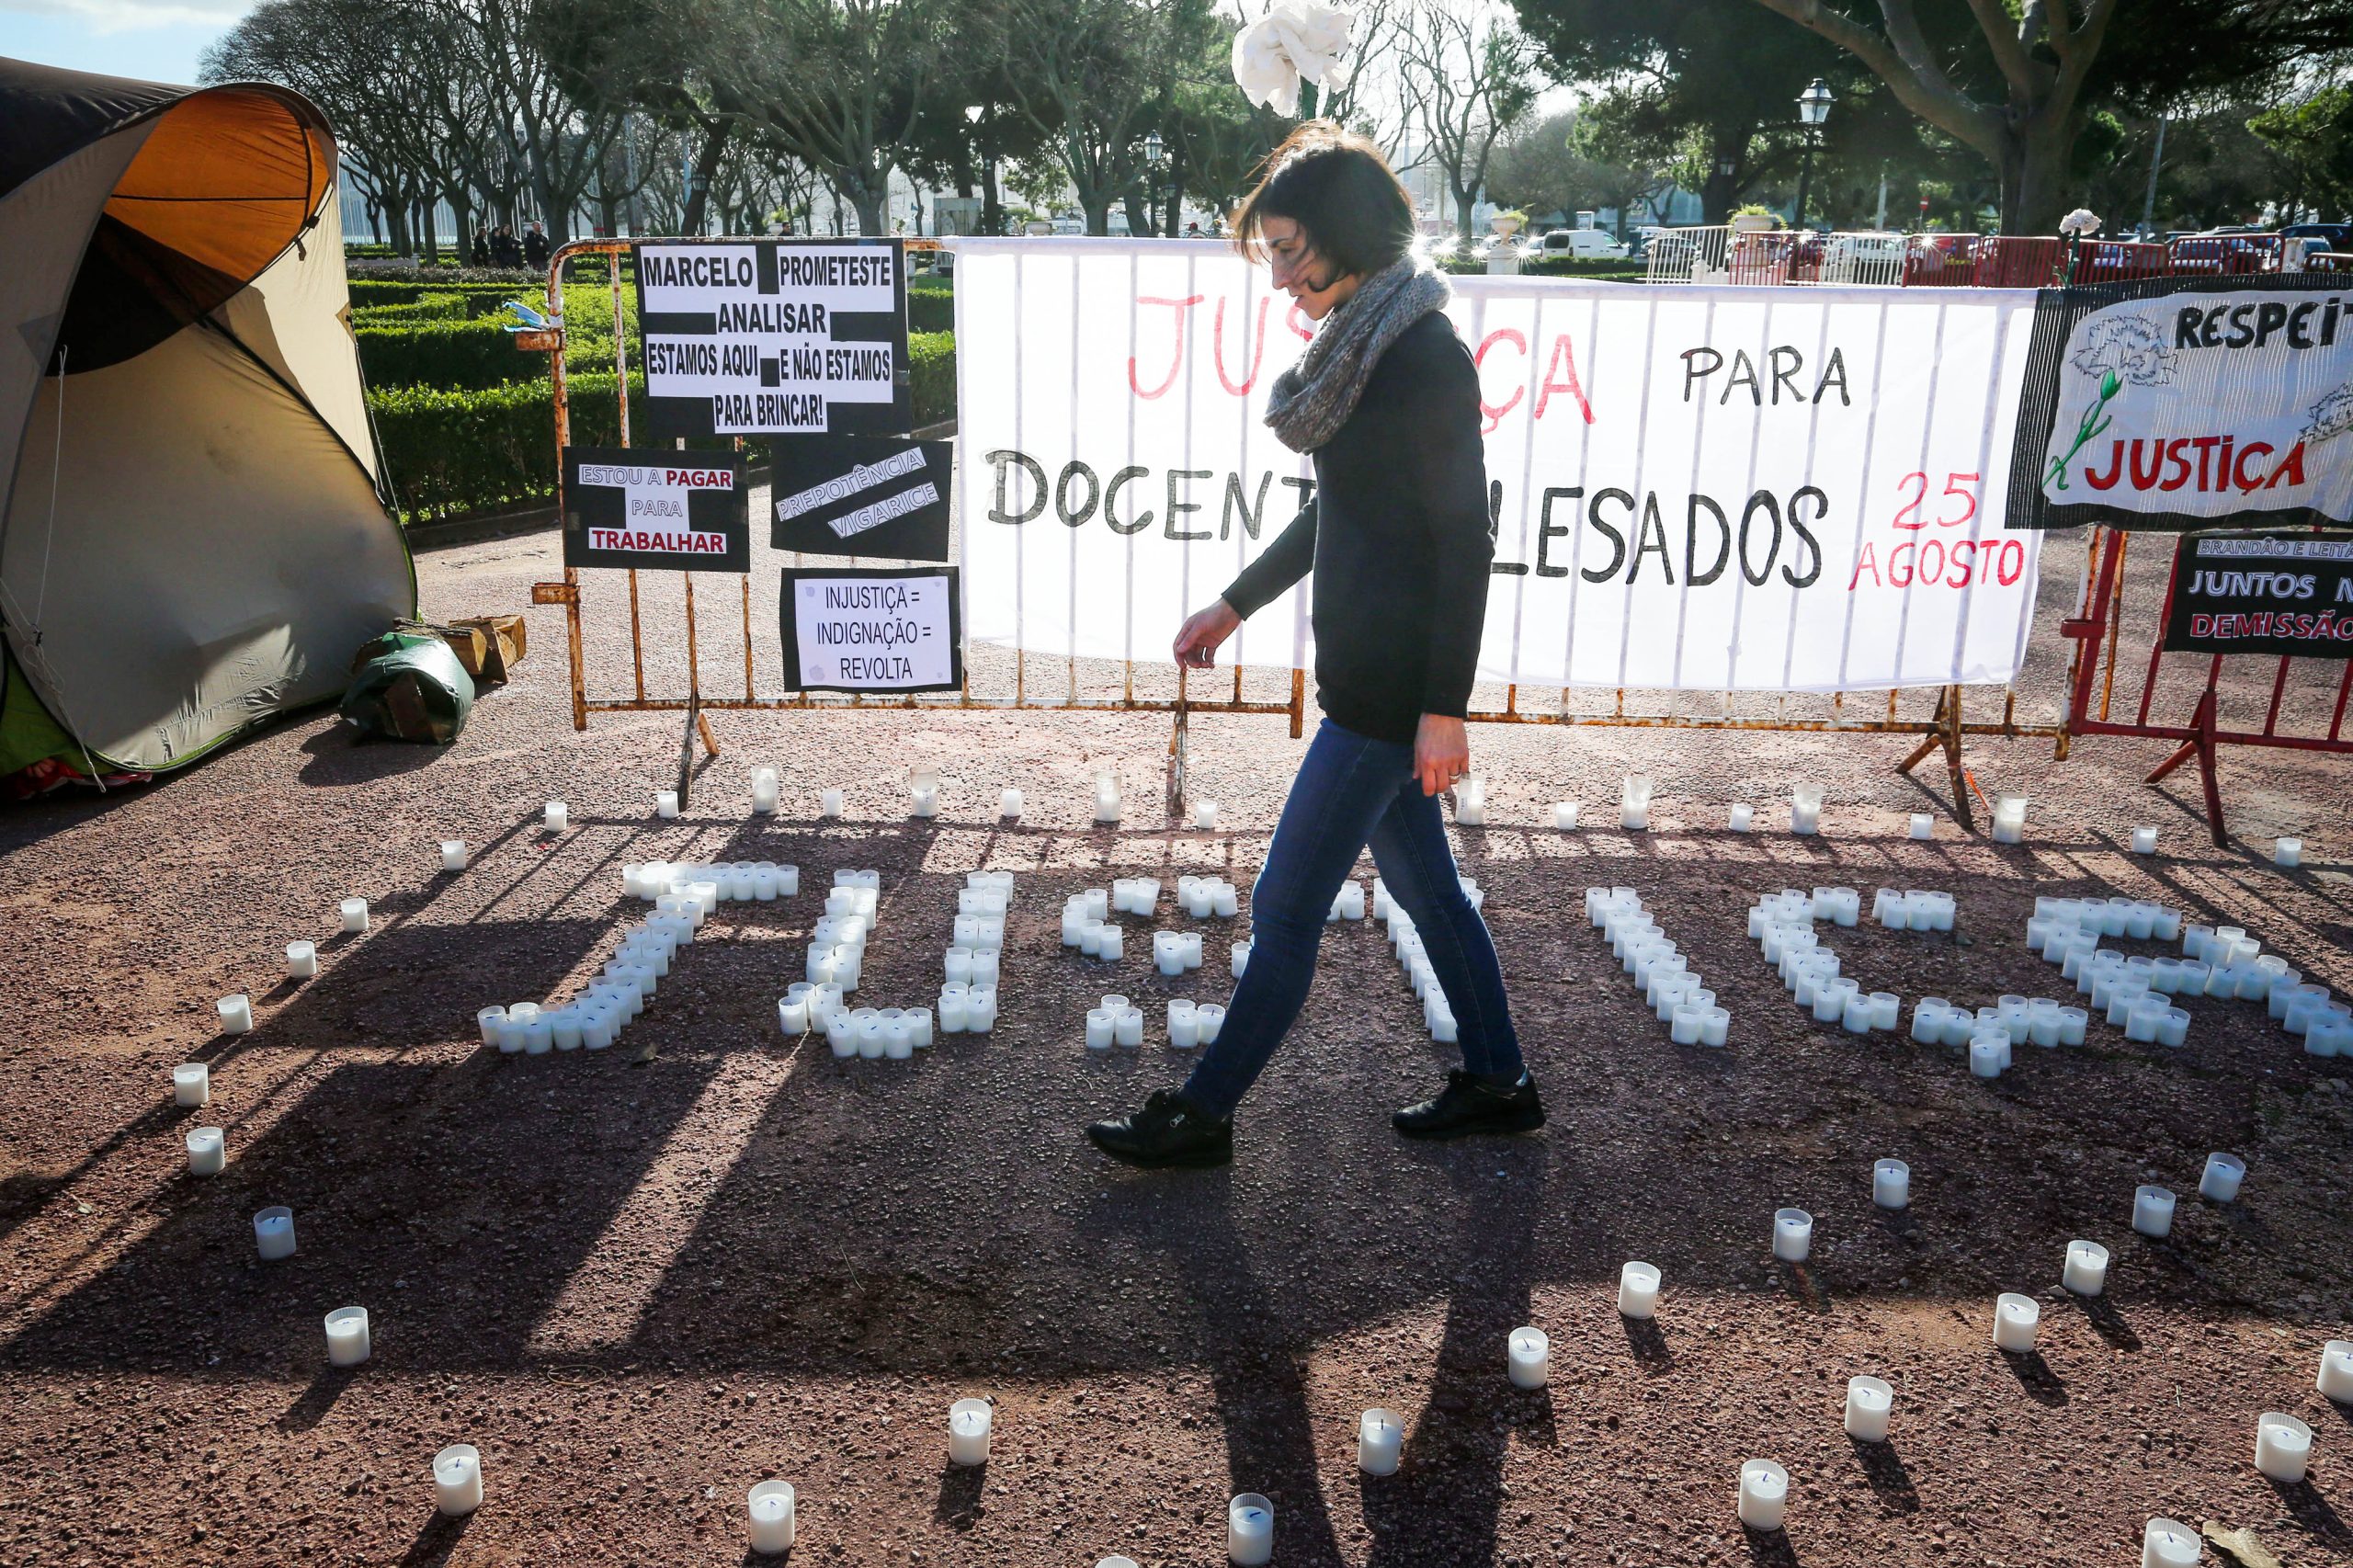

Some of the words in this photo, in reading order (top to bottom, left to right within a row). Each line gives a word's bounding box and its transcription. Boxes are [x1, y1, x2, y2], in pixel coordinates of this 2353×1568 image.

[643, 256, 754, 287] MARCELO
[779, 256, 891, 287] PROMETESTE
[718, 302, 826, 334] ANALISAR
[2175, 297, 2353, 350] RESPEI
[647, 343, 717, 376] ESTAMOS
[722, 344, 758, 379] AQUI
[780, 348, 789, 380] E
[793, 341, 822, 381] NÃO
[826, 349, 891, 381] ESTAMOS
[1128, 294, 1597, 435] JUÇA
[1679, 346, 1851, 406] PARA
[714, 394, 754, 426] PARA
[756, 393, 824, 426] BRINCAR!
[581, 466, 642, 485] ESTOU
[647, 470, 662, 485] A
[666, 470, 732, 488] PAGAR
[2084, 434, 2306, 496] JUSTIÇA
[778, 449, 925, 521] PREPOTÊNCIA
[1892, 471, 1981, 530] 25
[631, 499, 683, 517] PARA
[828, 483, 939, 538] VIGARICE
[984, 449, 1318, 540] DOCENT
[1489, 479, 1829, 589] LESADOS
[592, 529, 724, 553] TRABALHAR
[2199, 538, 2289, 556] BRANDÃO
[2292, 542, 2305, 556] E
[1847, 538, 2024, 592] AGOSTO
[824, 585, 908, 615] INJUSTIÇA
[911, 591, 920, 602] =
[2188, 570, 2317, 599] JUNTOS
[816, 618, 918, 651] INDIGNAÇÃO
[922, 626, 932, 637] =
[840, 657, 913, 679] REVOLTA
